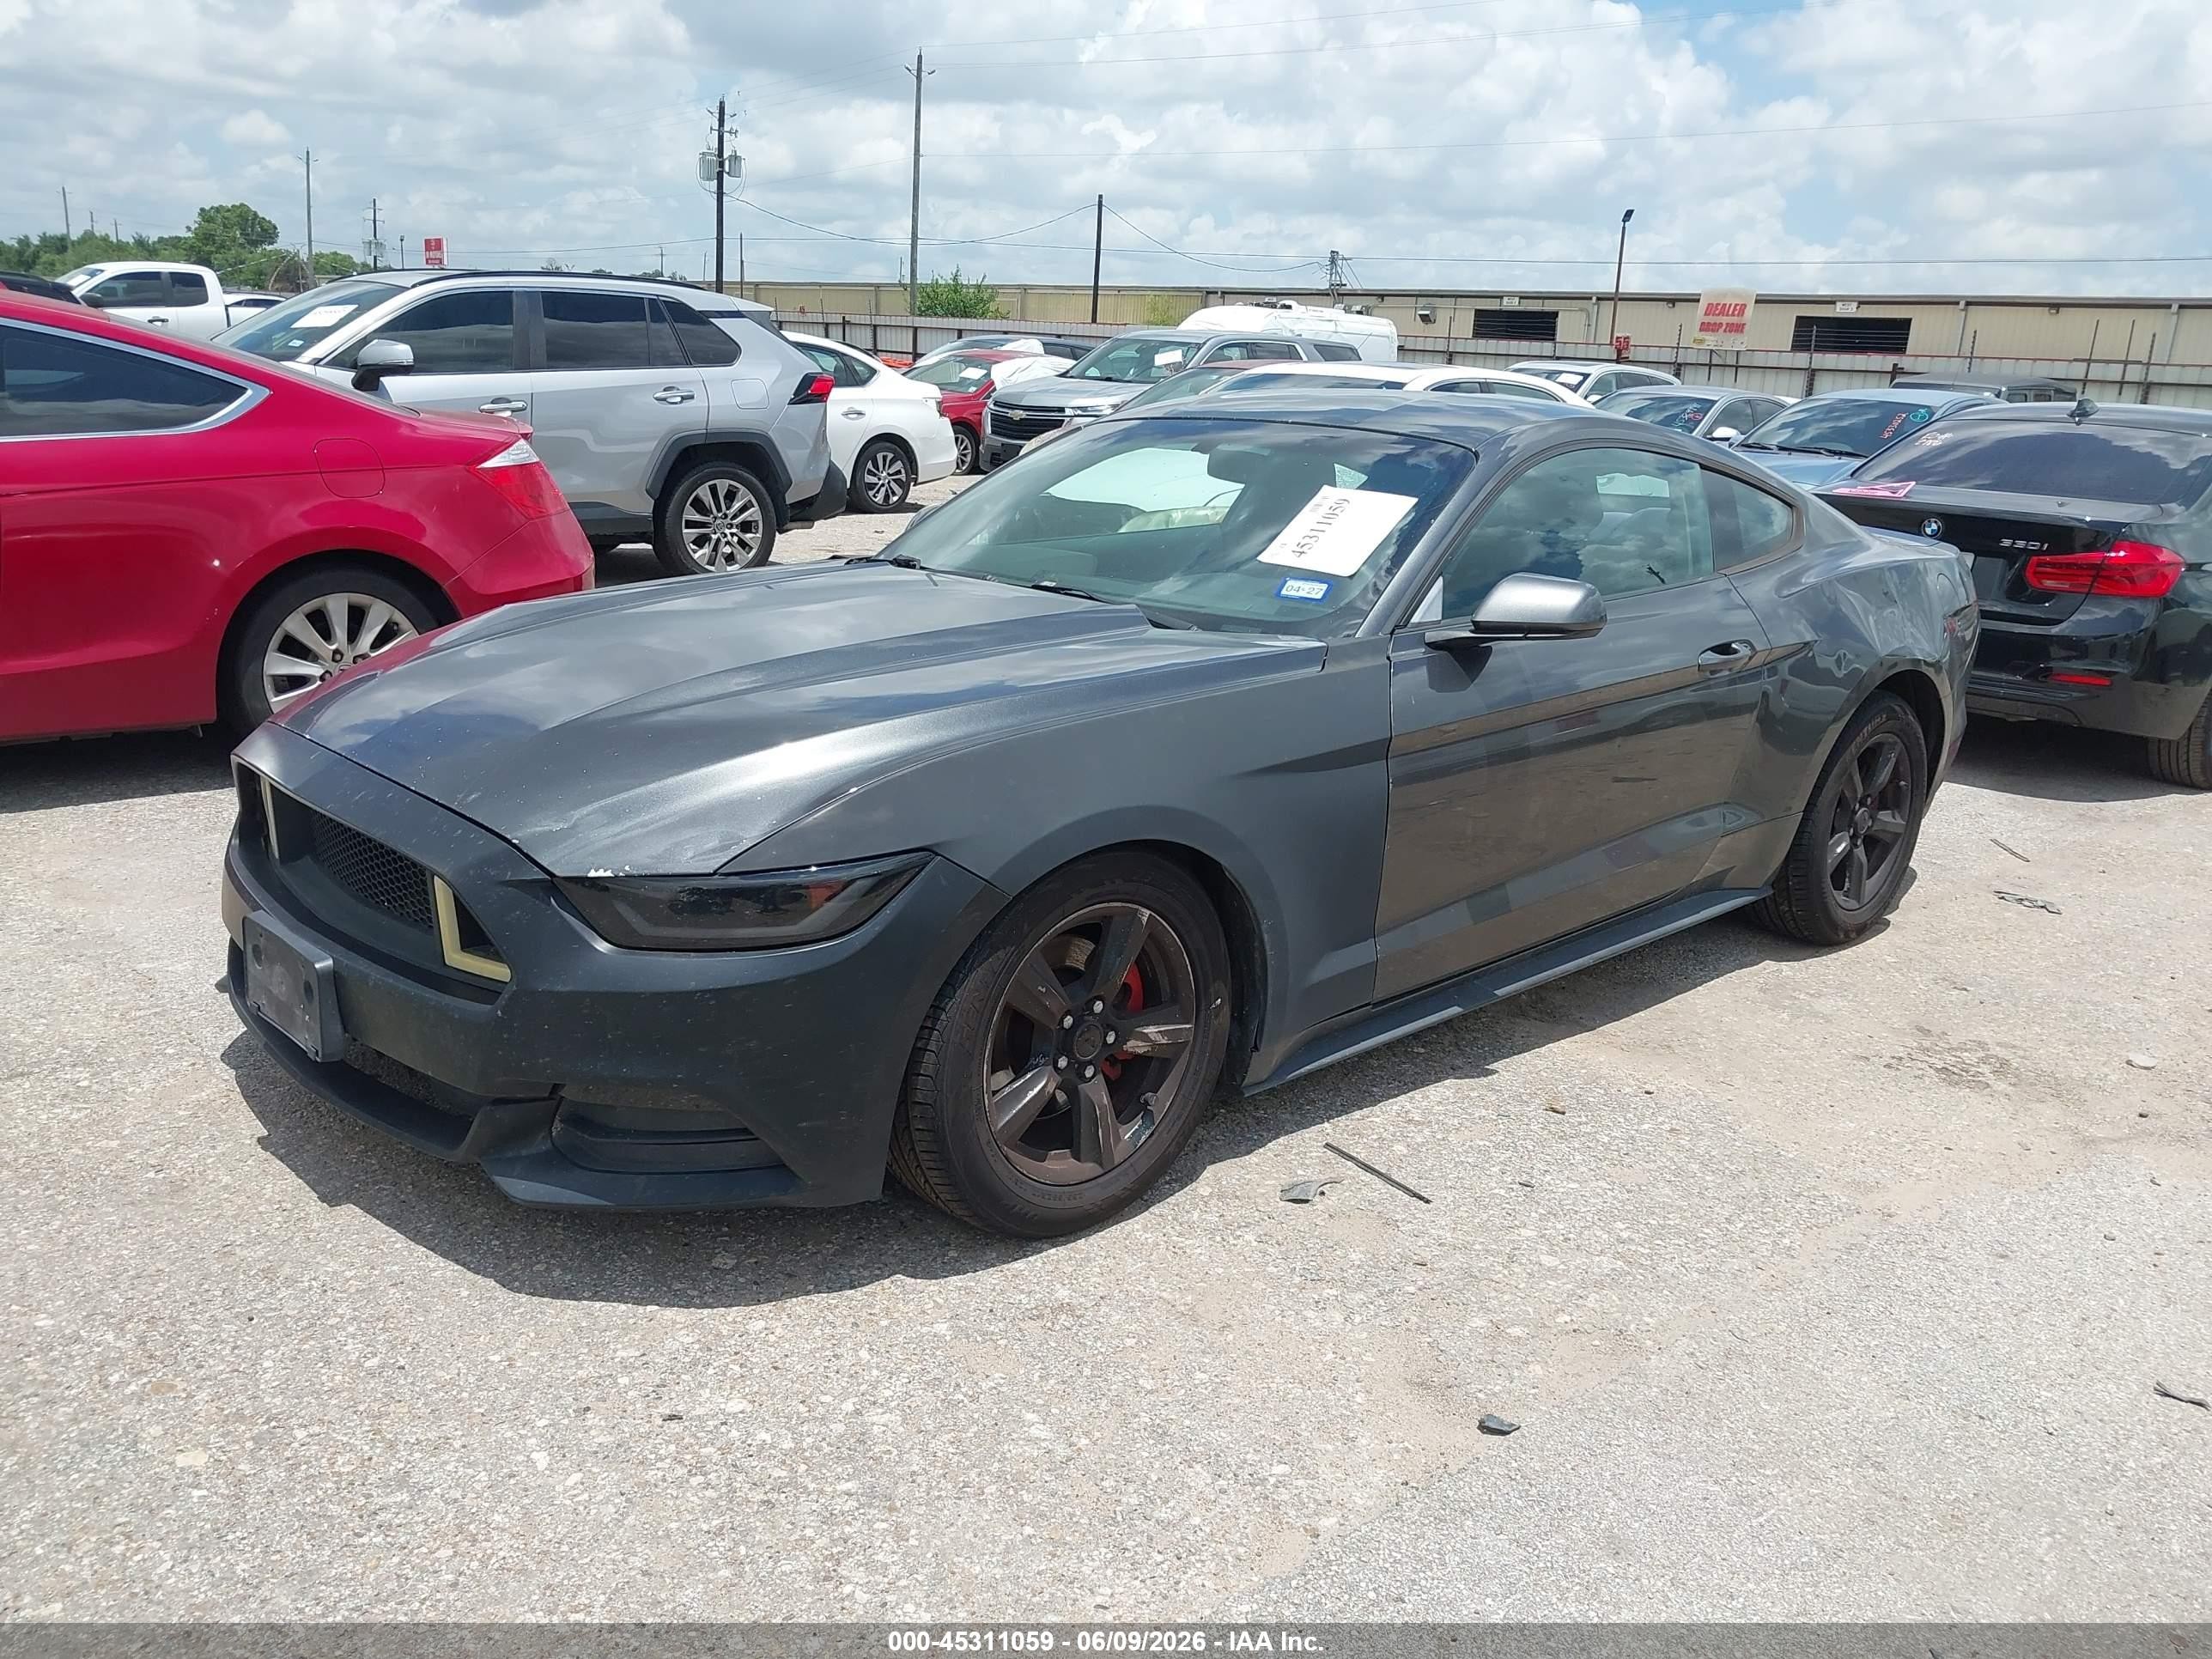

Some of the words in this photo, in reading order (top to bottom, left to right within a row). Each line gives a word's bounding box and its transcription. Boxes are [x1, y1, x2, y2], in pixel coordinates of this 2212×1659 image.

[1704, 302, 1747, 317] DEALER
[1699, 321, 1723, 333] DROP
[1723, 322, 1747, 333] ZONE
[1291, 498, 1350, 557] 45311059
